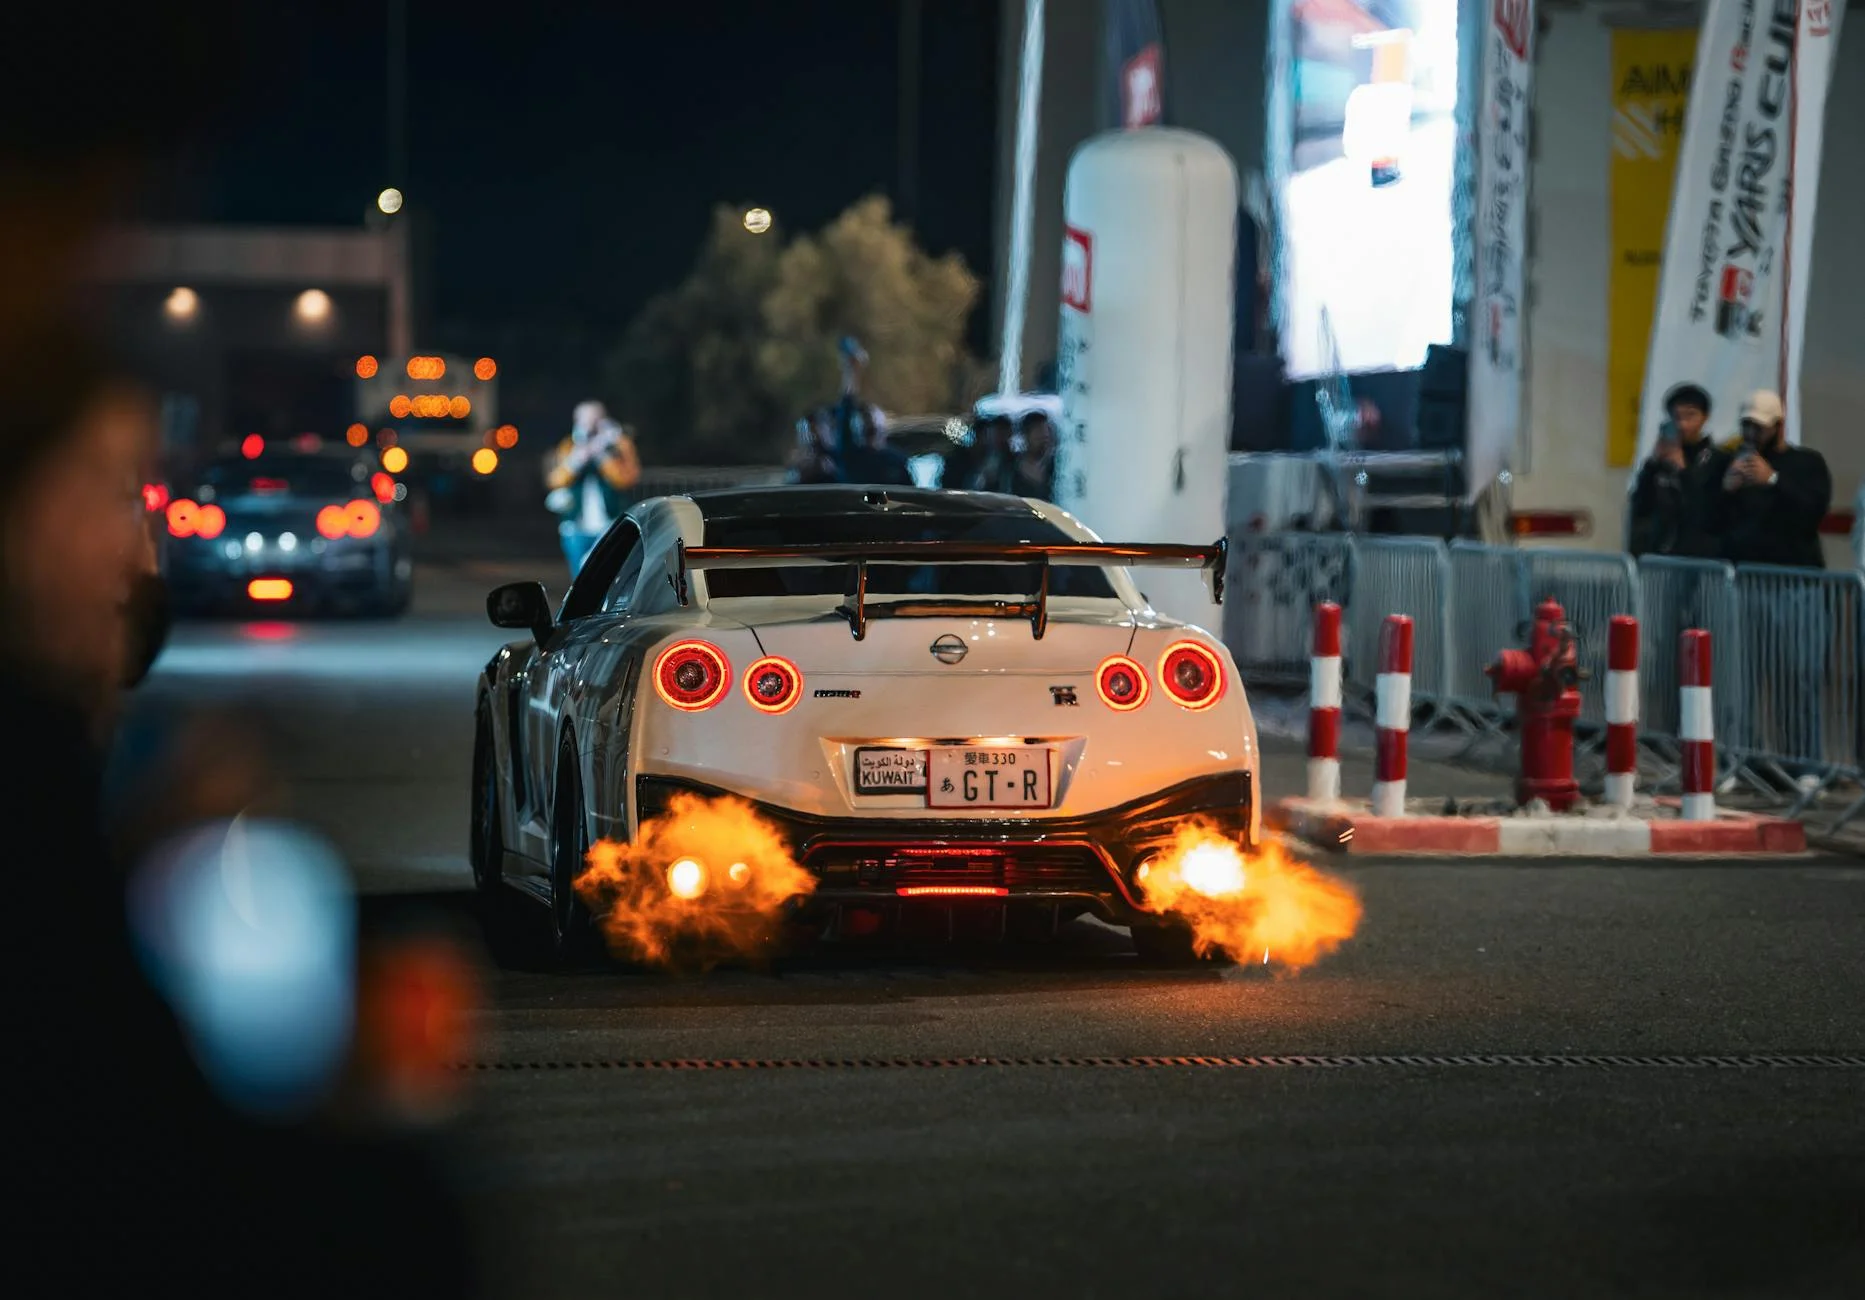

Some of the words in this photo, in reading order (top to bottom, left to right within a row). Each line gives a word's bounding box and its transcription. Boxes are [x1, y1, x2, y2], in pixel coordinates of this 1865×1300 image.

[1725, 119, 1778, 260] YARIS
[862, 757, 892, 770] الكويت
[893, 754, 915, 769] دولة
[862, 770, 914, 786] KUWAIT
[940, 777, 955, 793] あ
